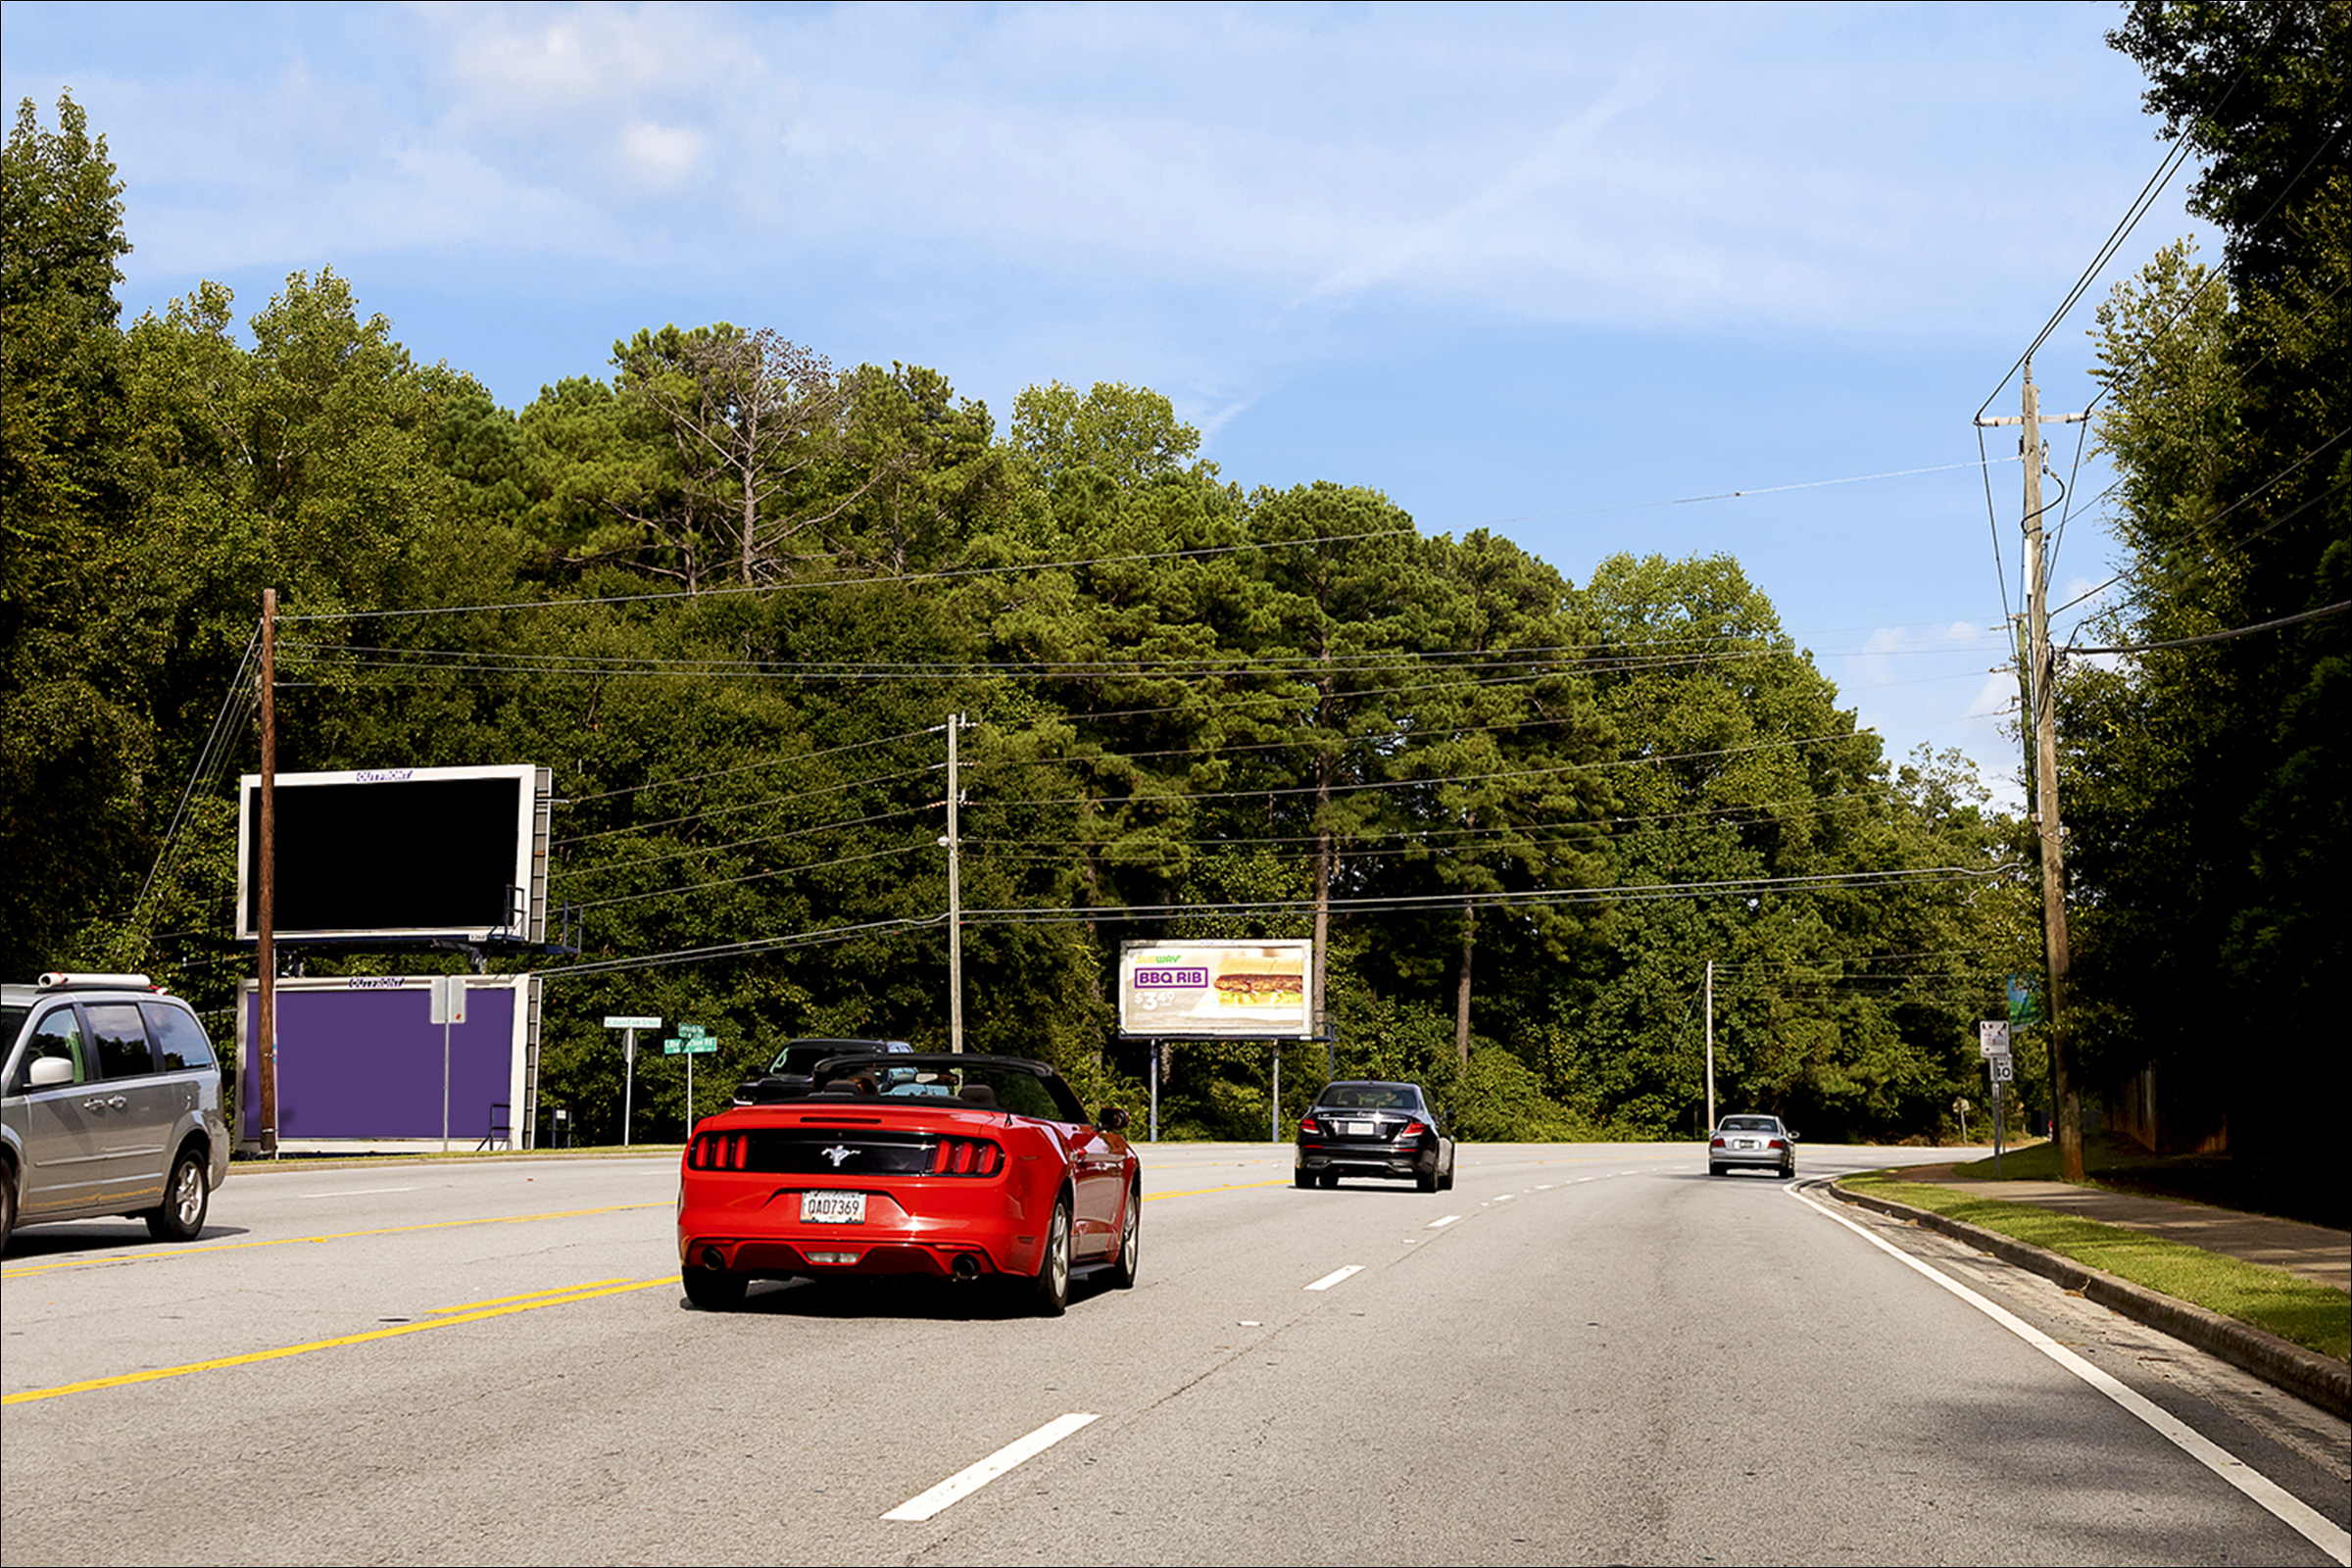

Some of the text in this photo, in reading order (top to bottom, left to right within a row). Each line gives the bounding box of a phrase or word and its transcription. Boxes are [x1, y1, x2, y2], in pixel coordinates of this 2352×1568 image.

[357, 769, 413, 781] OUTFRONT
[1135, 955, 1181, 964] SUBWAY
[349, 977, 405, 988] OUTFRONT
[1140, 972, 1201, 983] BBQ RIB
